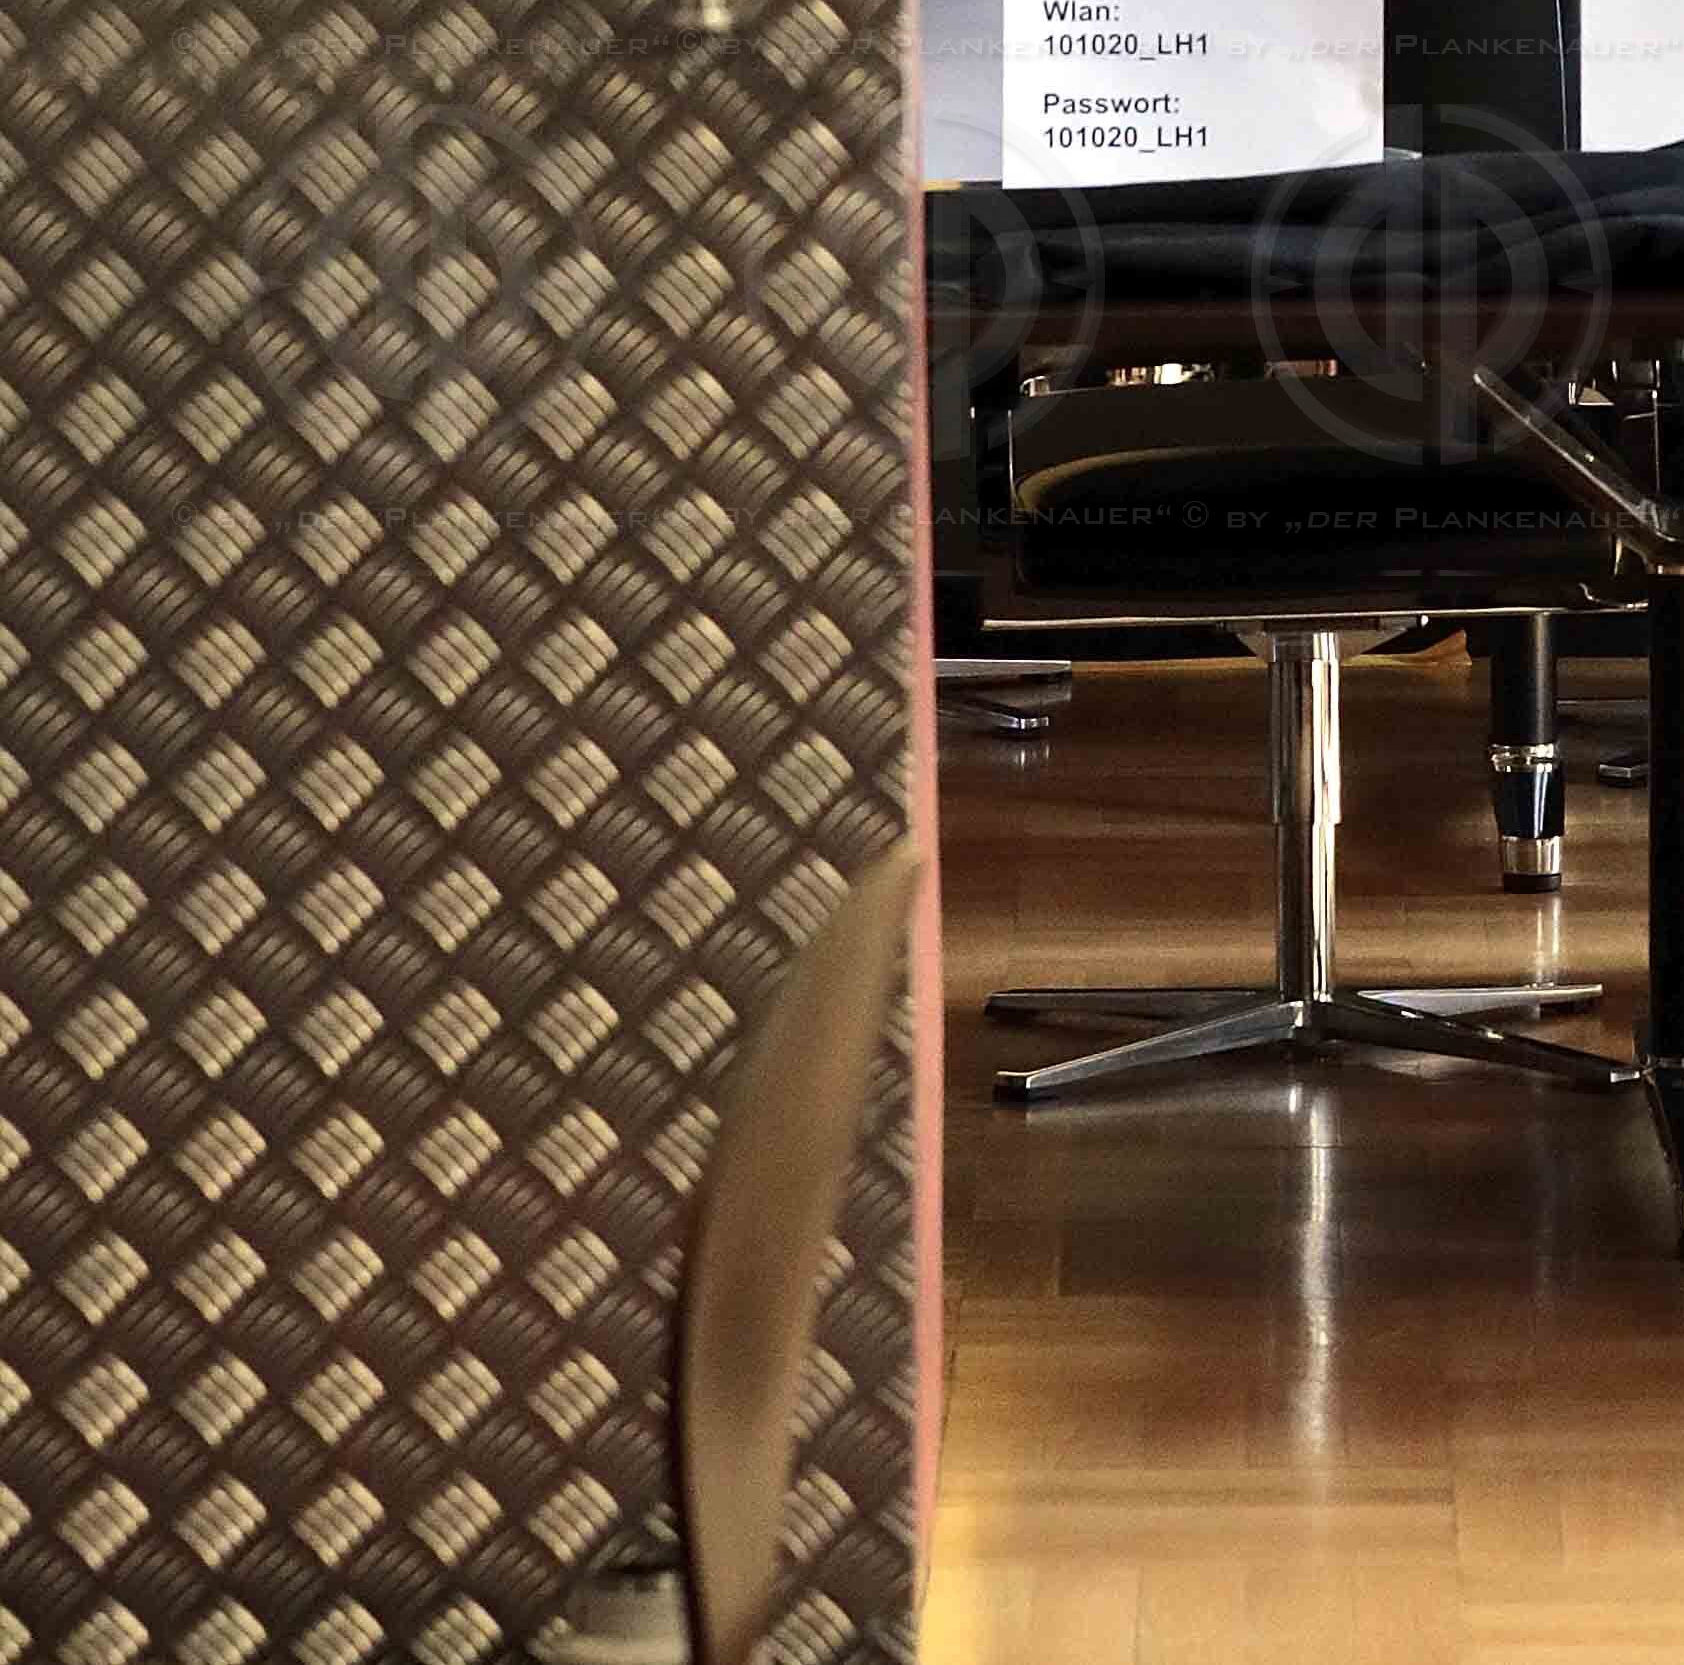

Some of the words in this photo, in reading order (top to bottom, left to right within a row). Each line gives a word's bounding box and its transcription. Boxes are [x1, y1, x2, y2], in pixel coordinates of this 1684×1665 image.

[1043, 0, 1120, 22] Wlan:
[1043, 33, 1209, 61] 101020_LH1
[1043, 93, 1181, 115] Passwort:
[1043, 126, 1209, 153] 101020_LH1
